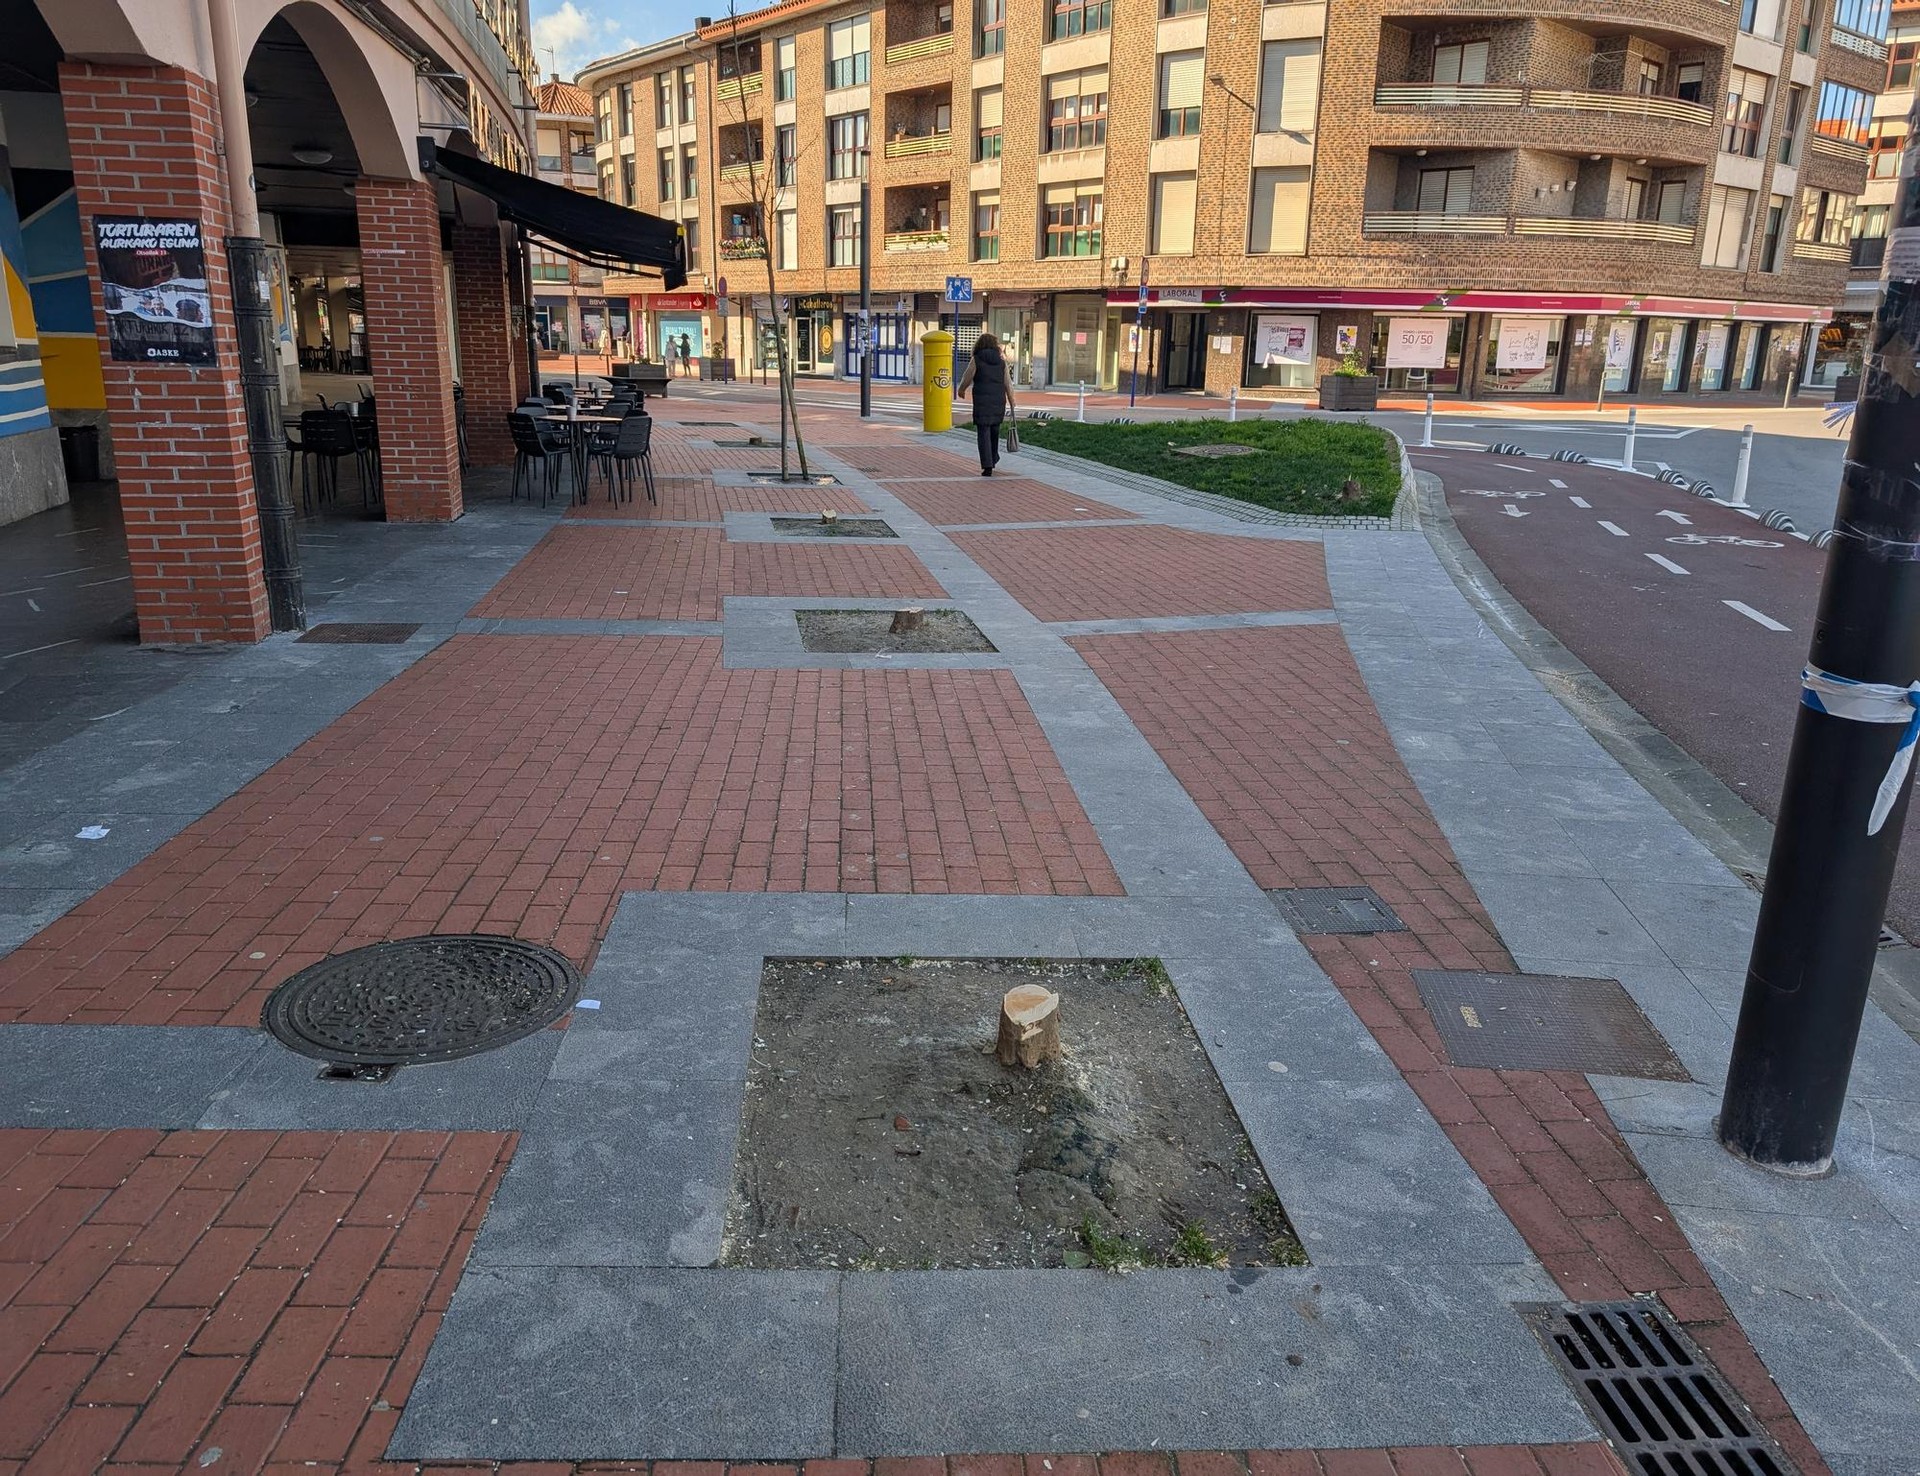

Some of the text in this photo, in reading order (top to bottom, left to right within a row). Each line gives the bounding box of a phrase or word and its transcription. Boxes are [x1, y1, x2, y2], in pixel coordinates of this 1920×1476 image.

[98, 223, 196, 237] TORTURAREN
[99, 238, 199, 249] AURKAKO EGUNA
[1162, 289, 1197, 298] LABORAL
[1401, 334, 1433, 345] 50/50
